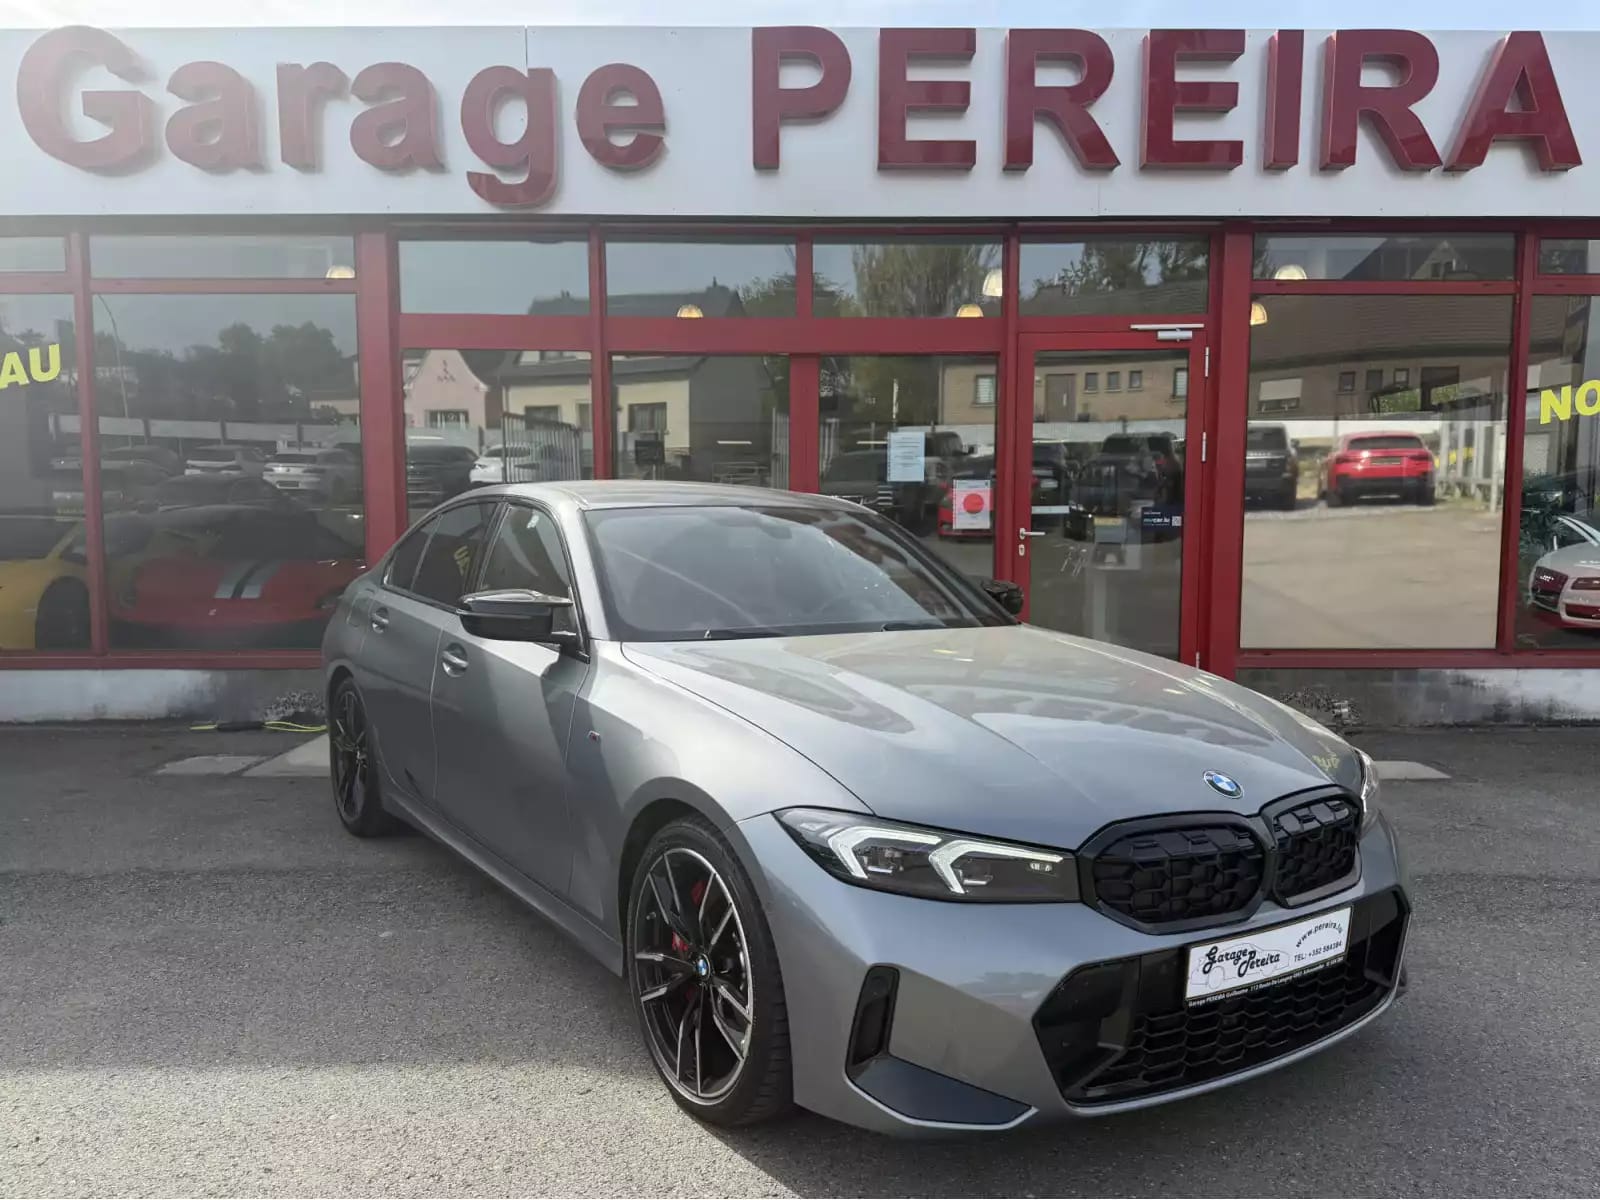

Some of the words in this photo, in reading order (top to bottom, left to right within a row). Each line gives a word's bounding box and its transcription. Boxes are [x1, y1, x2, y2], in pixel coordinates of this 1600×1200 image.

[17, 25, 667, 208] Garage
[752, 26, 1582, 172] PEREIRA
[0, 343, 61, 389] AU
[1203, 946, 1248, 974] Garage
[1238, 950, 1280, 977] Pereira
